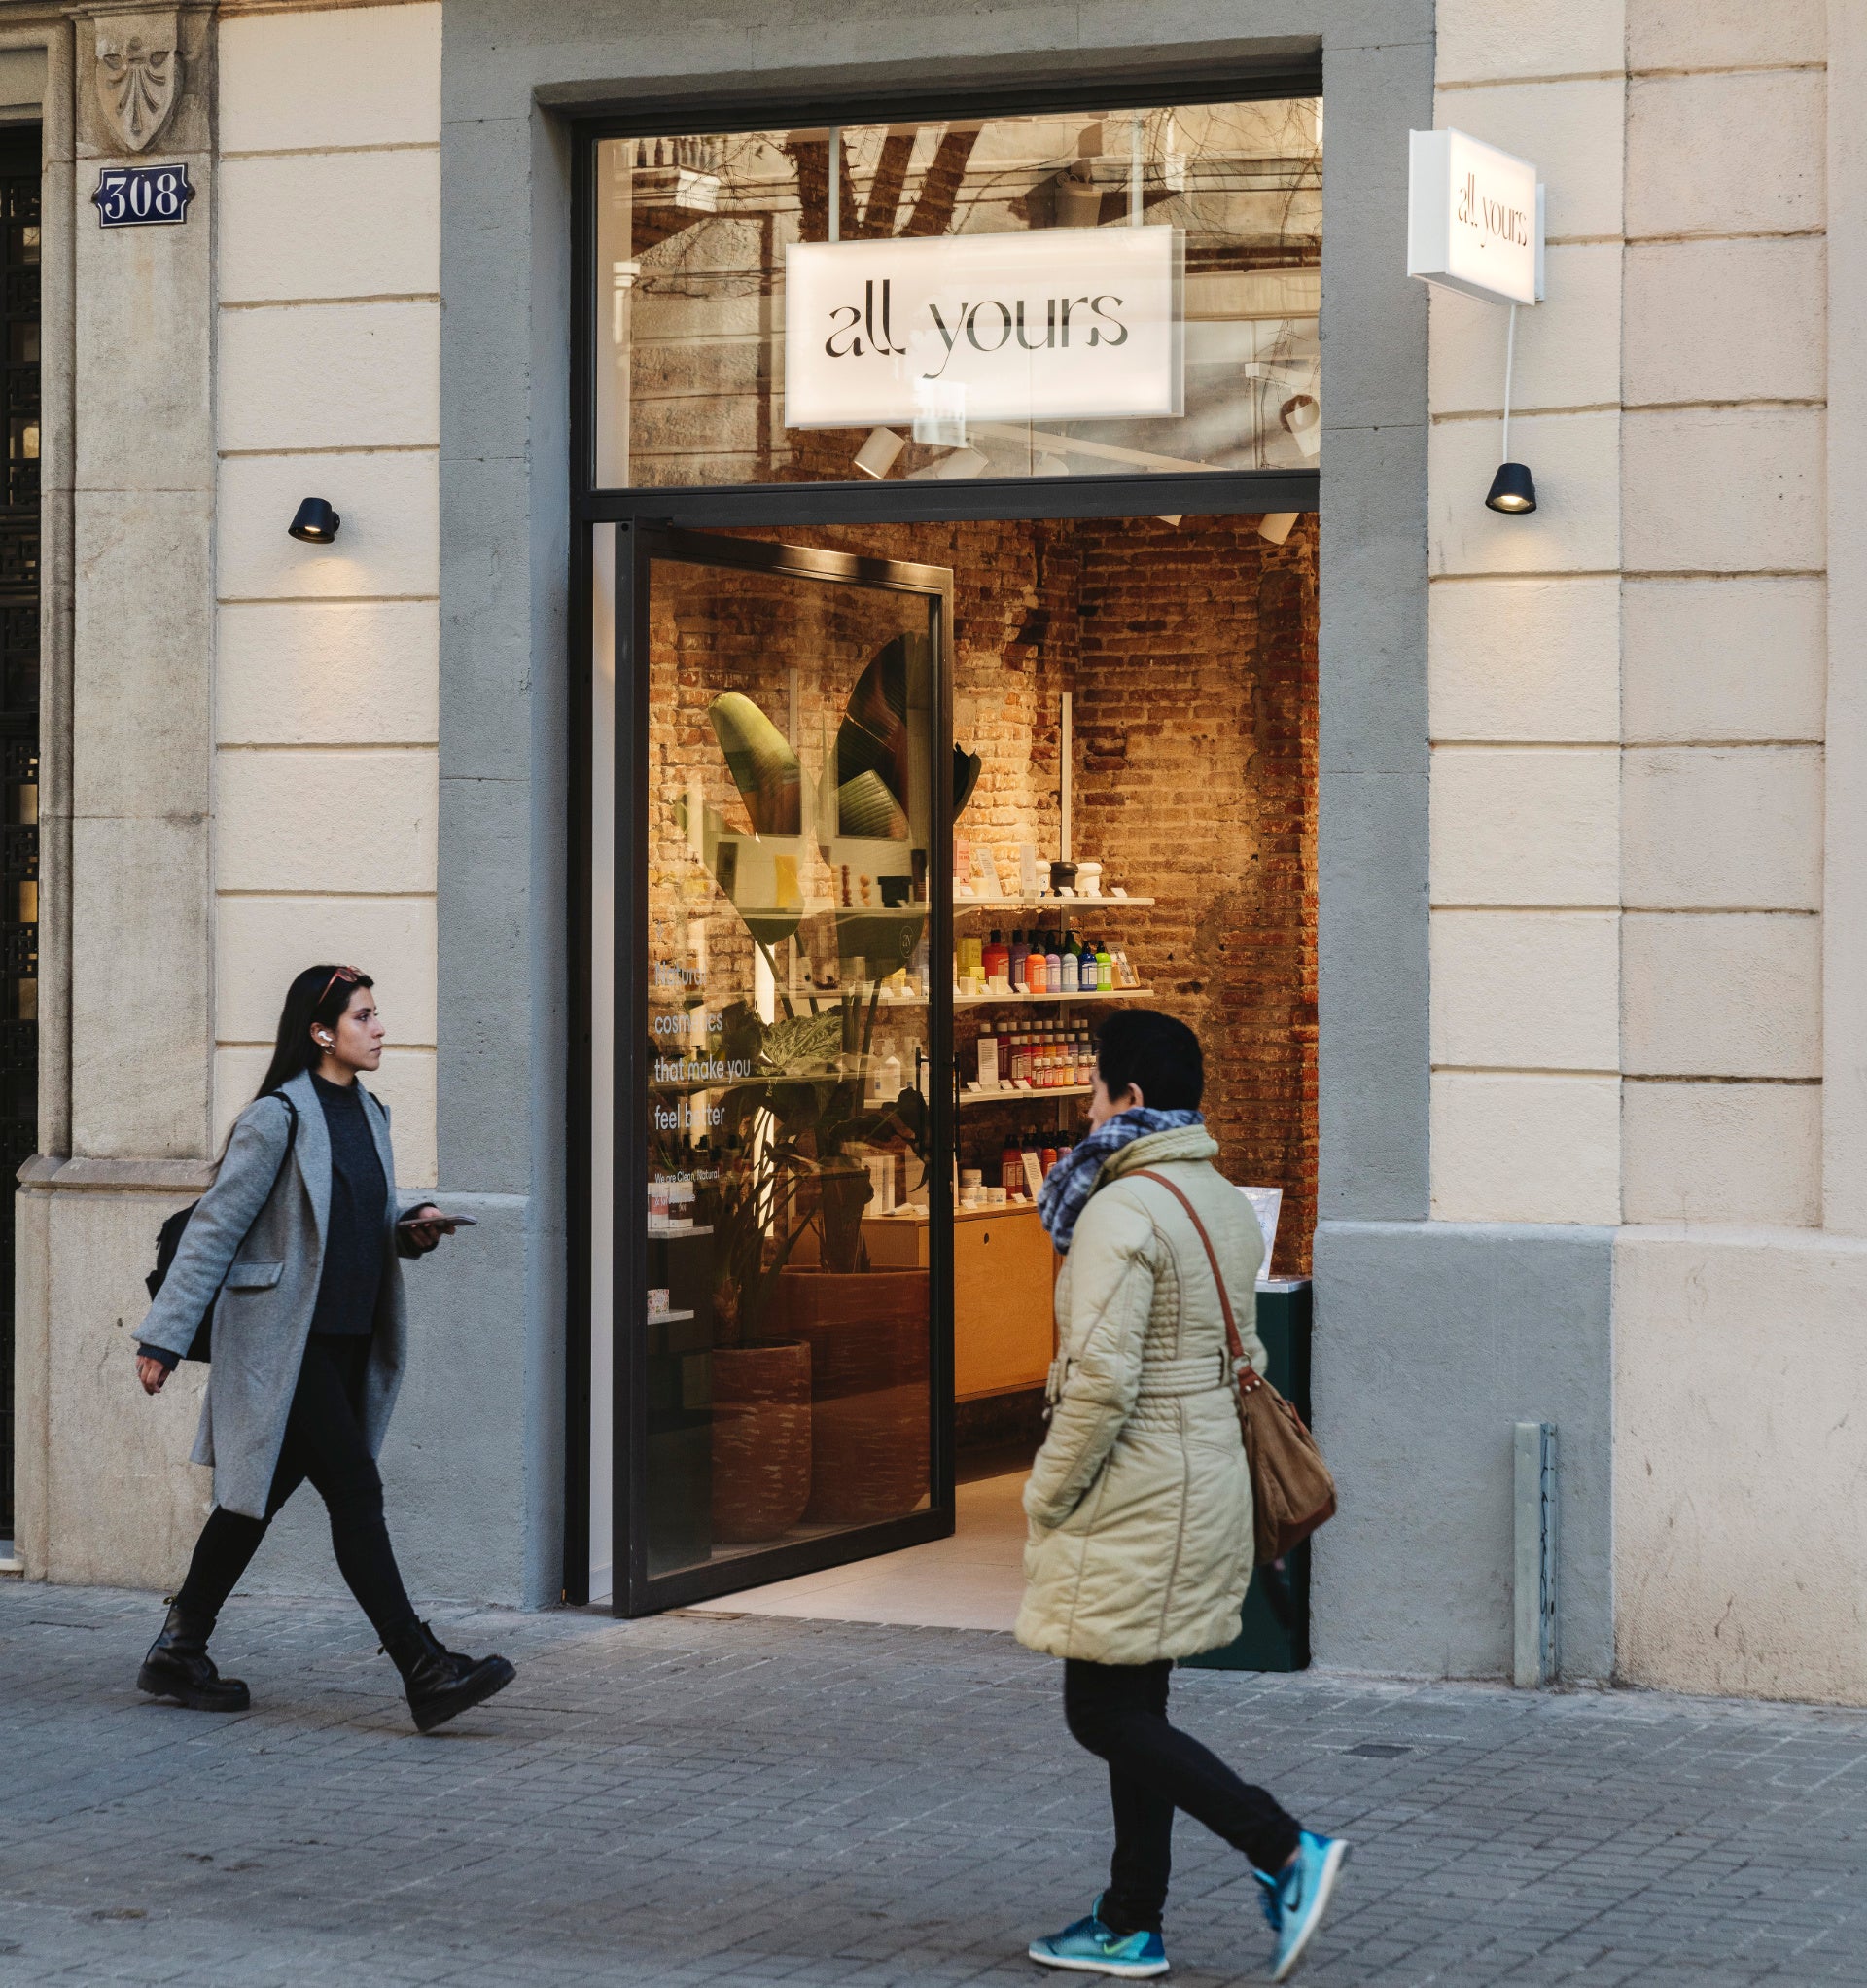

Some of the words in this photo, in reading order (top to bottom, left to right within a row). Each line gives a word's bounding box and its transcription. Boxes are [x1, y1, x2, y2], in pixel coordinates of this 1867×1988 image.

[105, 173, 178, 219] 308
[1458, 172, 1478, 228] all
[1480, 196, 1527, 248] yours
[825, 279, 906, 358] all
[922, 295, 1128, 379] yours
[655, 960, 707, 986] Natural
[654, 1056, 685, 1082] that
[687, 1053, 724, 1081] make
[727, 1058, 751, 1084] you
[654, 1104, 681, 1130] feel
[654, 1172, 665, 1184] We
[666, 1174, 677, 1183] are
[696, 1167, 720, 1180] Natural
